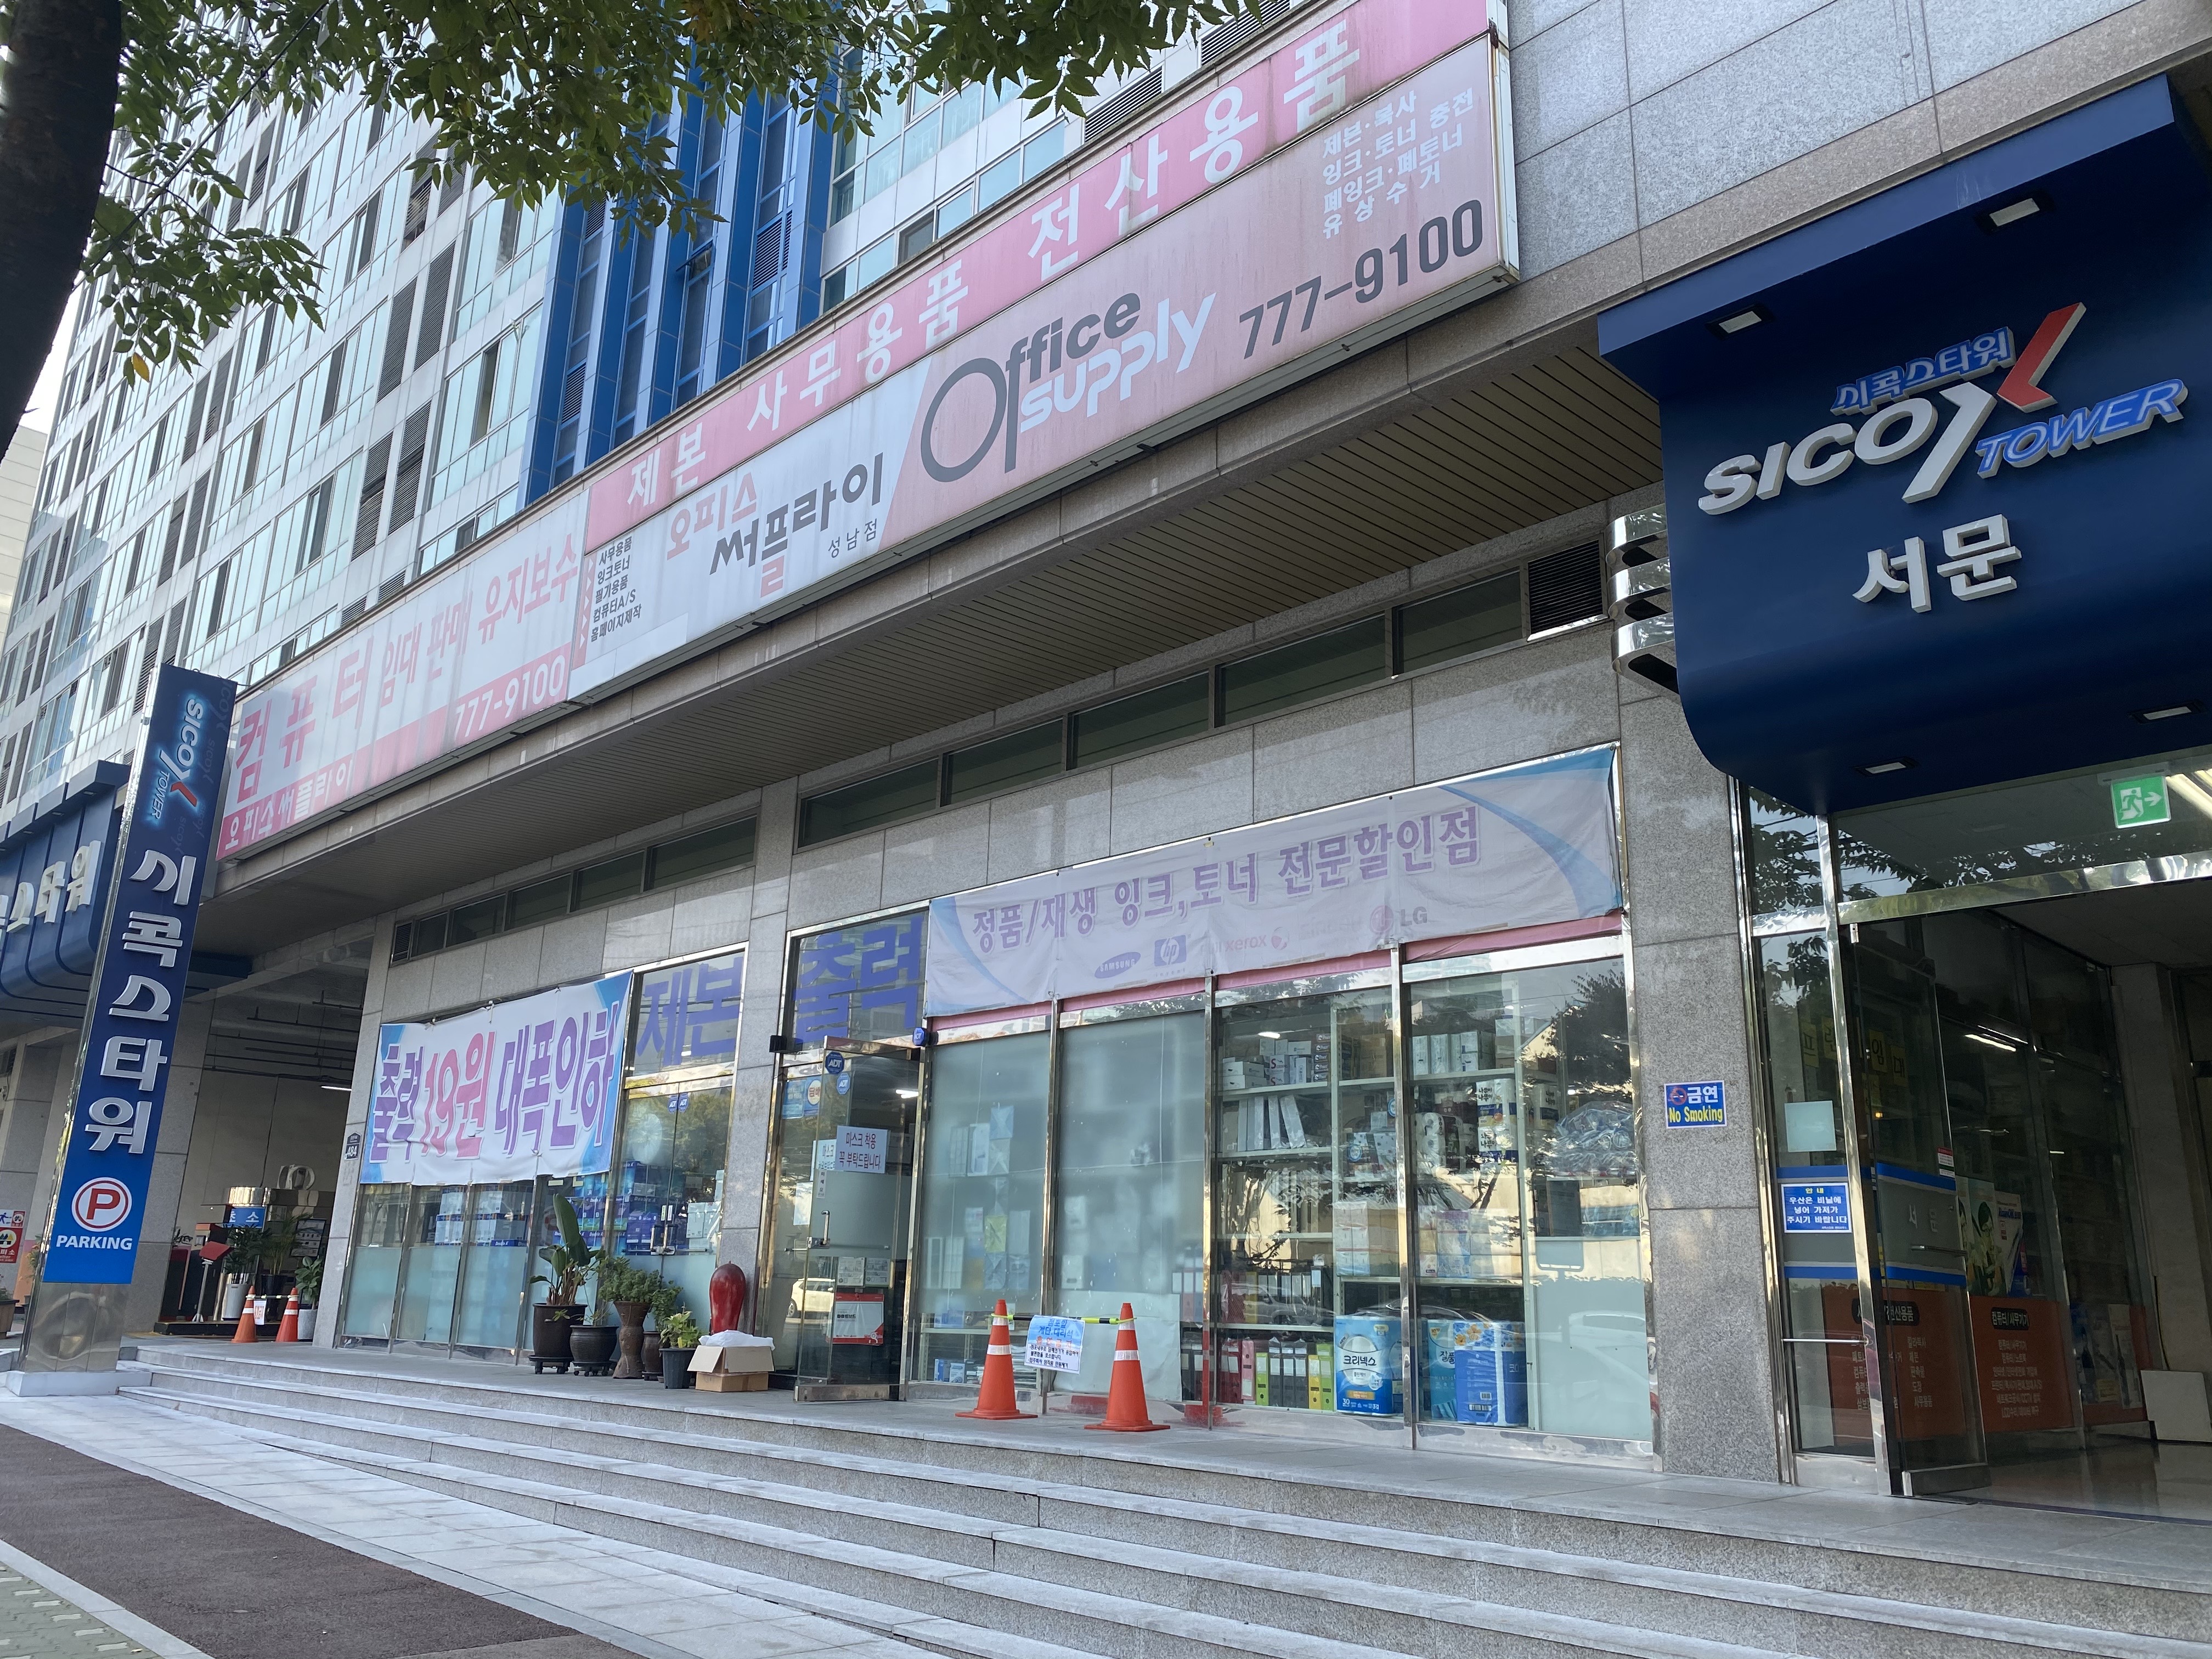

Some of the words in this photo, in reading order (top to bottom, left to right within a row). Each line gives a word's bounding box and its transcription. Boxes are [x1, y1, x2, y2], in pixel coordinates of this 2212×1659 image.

[1429, 88, 1474, 128] 충전
[628, 422, 706, 507] 제본
[747, 259, 968, 432] 사무용품
[1028, 19, 1360, 281] 전산용품
[1239, 199, 1482, 359] 777-9100
[921, 292, 1141, 482] Office
[1697, 302, 2087, 516] SICOX
[1976, 379, 2189, 479] TOWER
[666, 472, 757, 560] 오피스
[709, 452, 883, 599] 써플라이
[599, 536, 632, 566] 사무용품
[828, 518, 878, 559] 성남점
[597, 555, 630, 585] 잉크토너
[1852, 514, 2022, 613] 서문
[593, 589, 636, 623] 컴퓨터A/S
[595, 574, 628, 604] 필기용품
[591, 603, 642, 642] 홈페이지제작
[236, 637, 373, 803] 컴퓨터
[381, 622, 422, 707] 임대
[427, 591, 473, 680] 판매
[478, 533, 578, 645] 유지보수
[454, 655, 565, 740] 777-9100
[150, 771, 171, 820] TOWER
[0, 840, 101, 933] 스타워
[973, 887, 1096, 953] 정품/재생
[1114, 853, 1257, 927] 잉크,토너
[1278, 806, 1479, 895] 전문할인점
[1400, 906, 1427, 927] LG
[1225, 935, 1267, 952] xerox
[793, 916, 924, 1043] 출력
[1099, 958, 1136, 973] SAMSUNG
[636, 956, 743, 1065] 제본
[828, 1059, 842, 1068] ADT
[370, 1045, 424, 1163] 출력
[421, 1031, 495, 1159] 19원
[494, 1001, 620, 1156] 대폭인하
[839, 1079, 848, 1088] ADT
[1687, 1086, 1718, 1104] 금연
[1669, 1107, 1681, 1122] No
[1684, 1105, 1723, 1122] Smoking
[347, 1146, 357, 1157] 484
[845, 1132, 863, 1147] 마스크
[865, 1132, 876, 1149] 착용
[839, 1151, 845, 1167] 꼭
[86, 1188, 122, 1220] P
[1817, 1196, 1842, 1204] 비닐에
[1787, 1215, 1810, 1224] 주시기
[1814, 1215, 1847, 1224] 바랍니다
[56, 1234, 133, 1251] PARKING
[1343, 1355, 1377, 1367] 크리넥스
